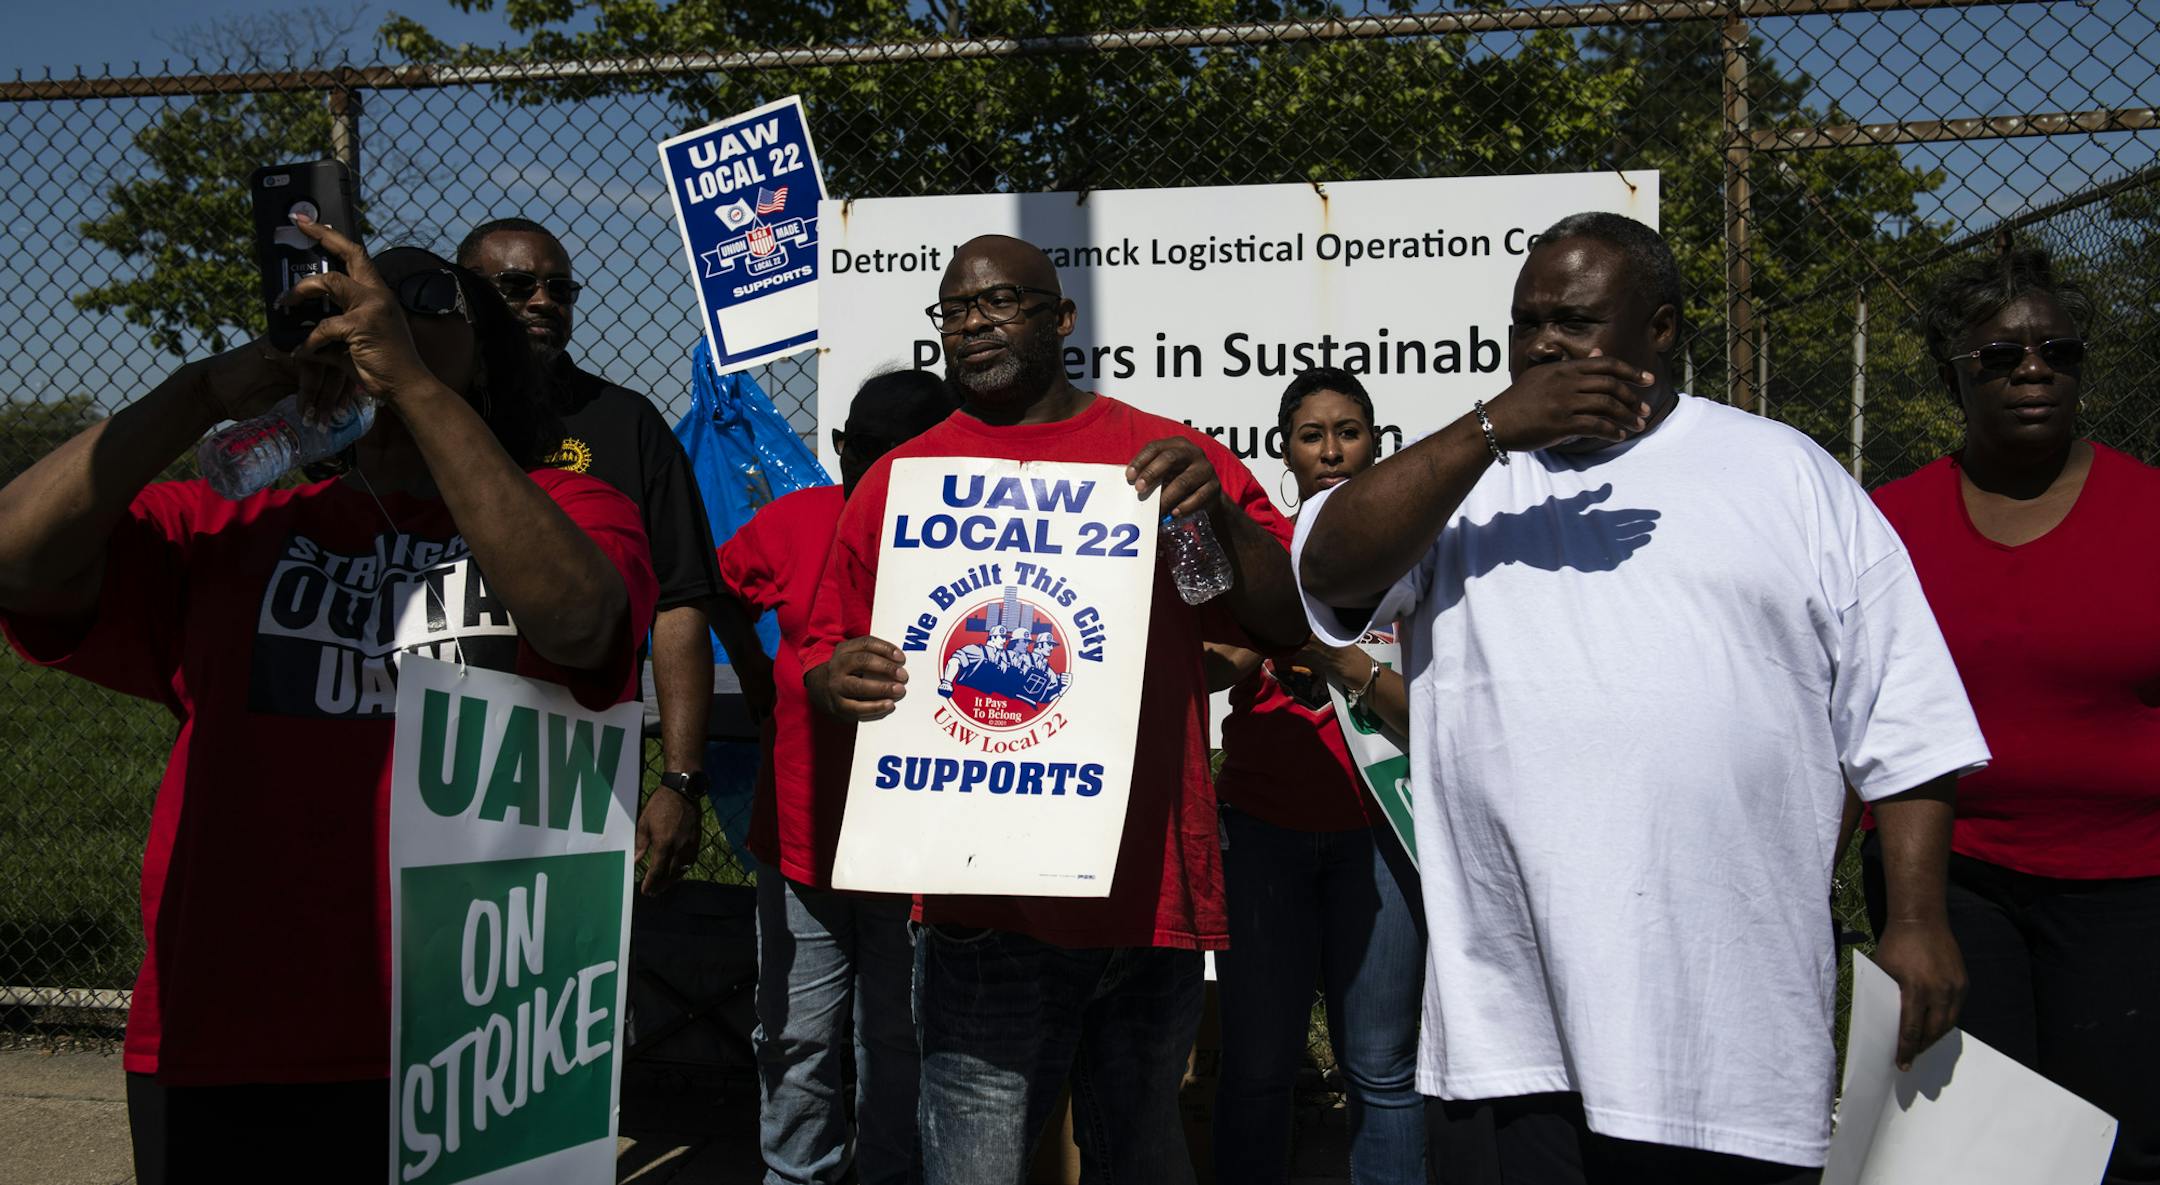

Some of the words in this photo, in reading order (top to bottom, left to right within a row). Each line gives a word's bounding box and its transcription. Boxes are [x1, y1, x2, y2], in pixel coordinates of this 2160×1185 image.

[688, 119, 779, 169] UAW
[685, 157, 766, 205] LOCAL
[769, 143, 804, 177] 22
[720, 240, 747, 257] UNION
[775, 222, 800, 239] MADE
[752, 229, 768, 240] USA
[832, 245, 940, 273] Detroit
[1152, 232, 1303, 271] Logistical
[1316, 229, 1490, 266] Operation
[733, 265, 813, 297] SUPPORTS
[754, 259, 773, 271] LOCAL
[773, 257, 782, 265] 22
[1156, 332, 1202, 378] in
[942, 474, 1096, 514] UAW
[893, 514, 1063, 554] LOCAL
[1076, 521, 1141, 557] 22
[903, 612, 938, 652] We
[928, 561, 1004, 611] Built
[1014, 561, 1077, 607] This
[1073, 606, 1104, 663] City
[973, 708, 985, 719] To
[988, 708, 1022, 722] Belong
[974, 697, 982, 707] It
[985, 697, 1008, 711] Pays
[934, 705, 979, 745] UAW
[981, 729, 1040, 753] Local
[1042, 712, 1068, 738] 22
[418, 688, 626, 835] UAW
[875, 754, 1105, 797] SUPPORTS
[461, 872, 548, 1006] ON
[402, 960, 617, 1182] STRIKE
